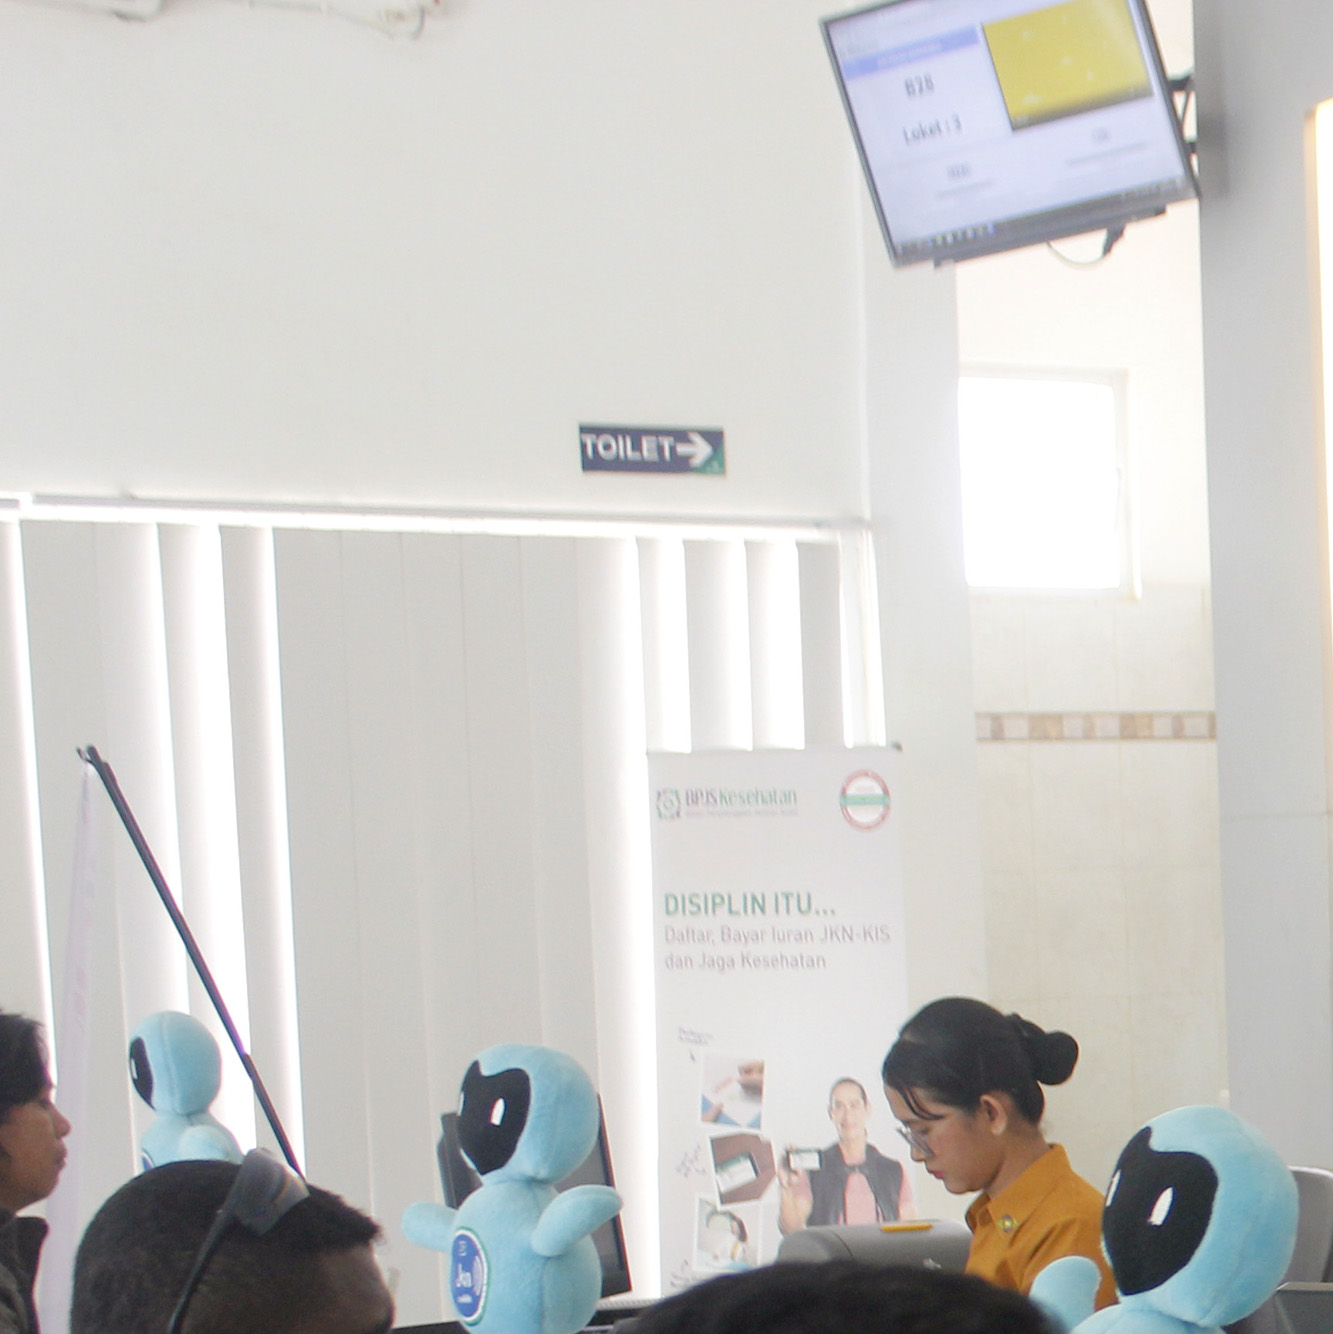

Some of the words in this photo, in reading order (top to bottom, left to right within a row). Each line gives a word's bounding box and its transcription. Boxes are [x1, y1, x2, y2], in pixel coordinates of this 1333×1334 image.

[580, 432, 675, 463] TOILET
[663, 891, 767, 917] DISIPLIN
[720, 924, 767, 947] Bayar
[819, 923, 892, 944] JKN-KIS
[664, 953, 694, 970] dan
[698, 952, 736, 974] Jaga
[740, 951, 827, 970] Kesehatan
